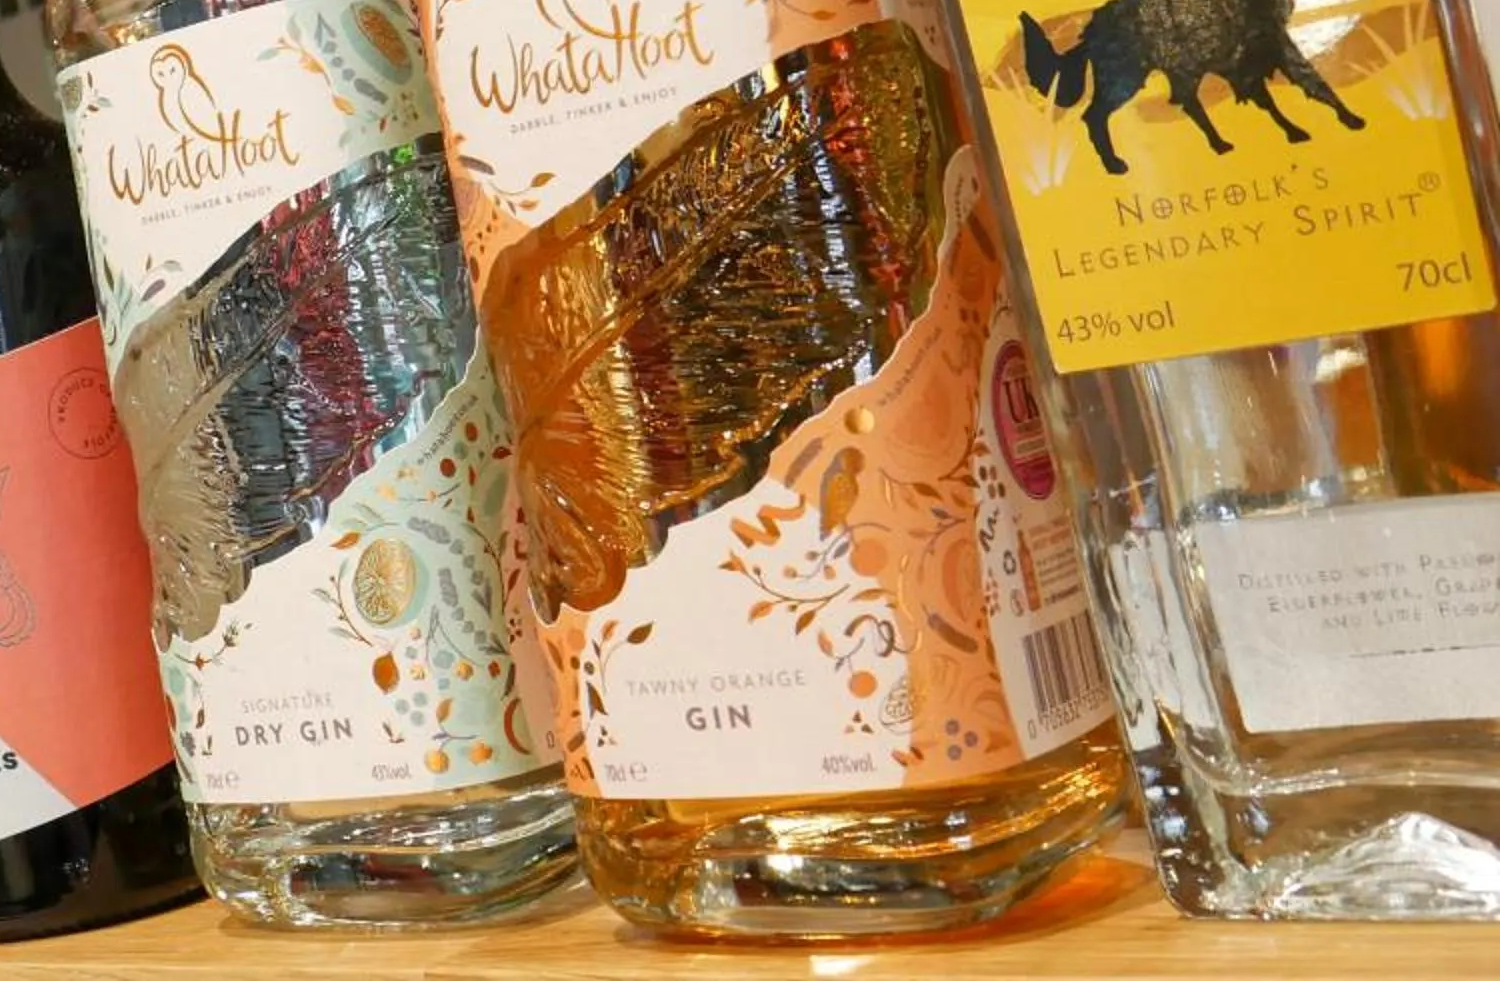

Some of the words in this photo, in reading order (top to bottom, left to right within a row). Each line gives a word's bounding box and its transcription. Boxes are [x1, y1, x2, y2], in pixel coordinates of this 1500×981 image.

[1116, 164, 1331, 226] NORFOLK'S
[1053, 222, 1264, 278] LEGENDARY
[1396, 252, 1473, 292] 70cl
[1056, 311, 1121, 345] 43%
[1129, 300, 1176, 332] vol
[626, 677, 699, 697] TAWNY
[709, 669, 807, 693] ORANGE
[240, 691, 334, 715] SIGNATURE
[685, 704, 753, 732] GIN
[234, 722, 283, 747] DRY
[299, 718, 354, 744] GIN
